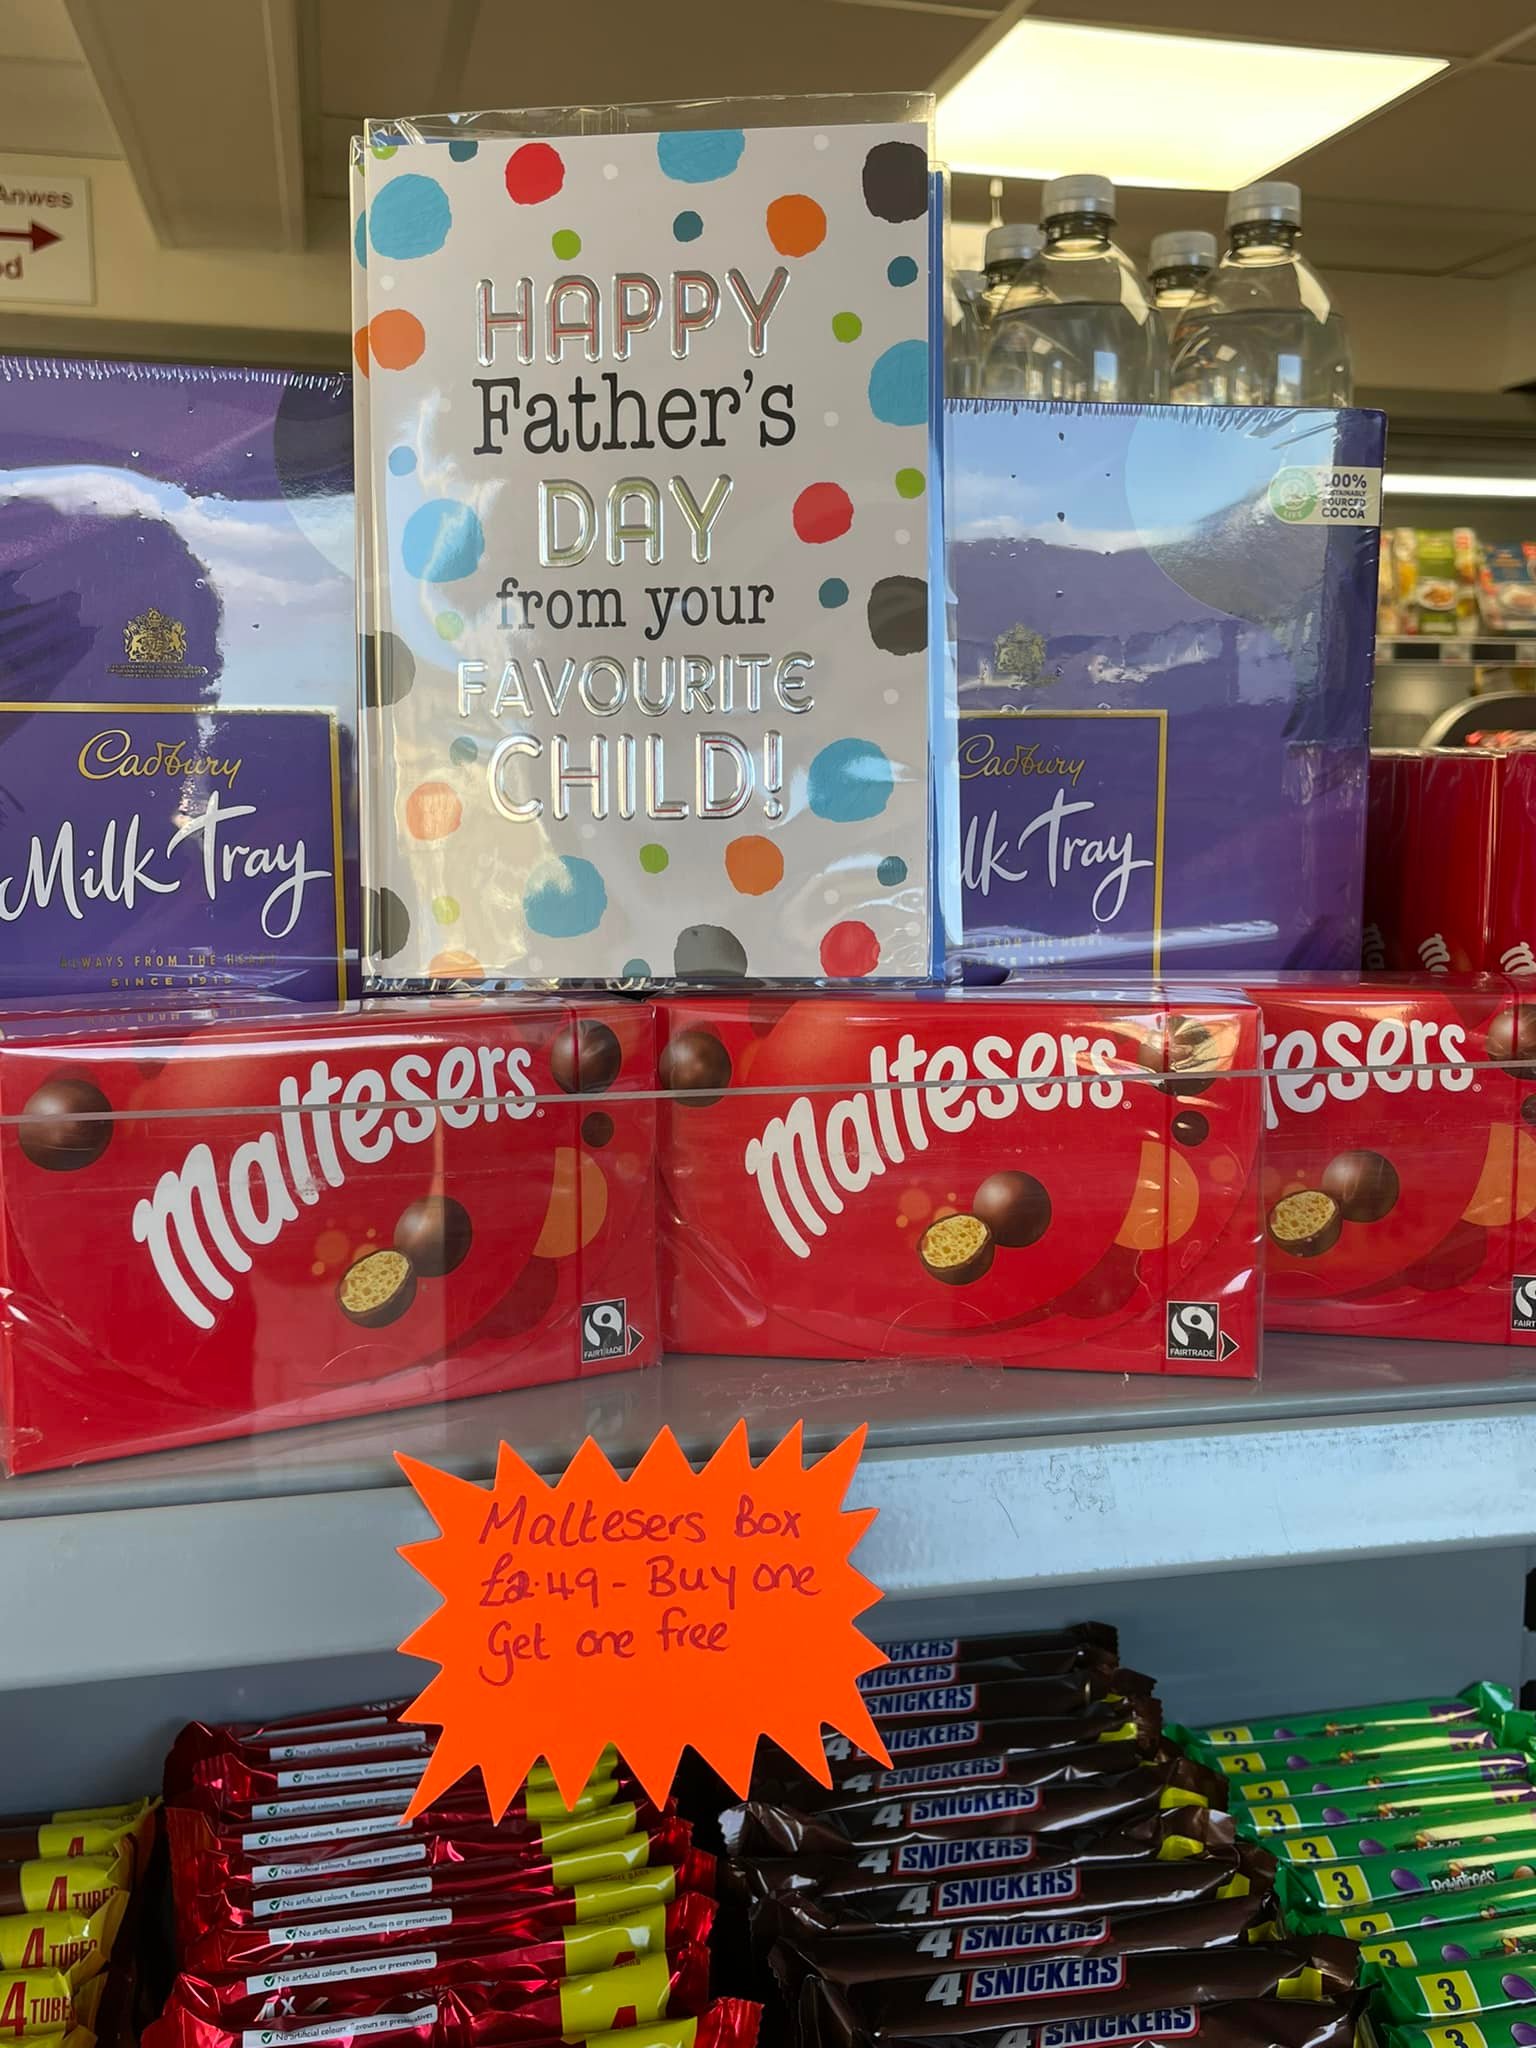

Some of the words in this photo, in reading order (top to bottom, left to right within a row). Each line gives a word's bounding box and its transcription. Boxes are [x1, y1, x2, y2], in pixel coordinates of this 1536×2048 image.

[475, 267, 790, 367] HAPPY
[472, 370, 796, 456] Father's
[537, 473, 734, 567] DAY
[1322, 508, 1365, 518] COCOA
[496, 577, 626, 630] from
[645, 583, 775, 641] your
[457, 651, 815, 718] FAVOURITE
[77, 729, 243, 789] Cadbury
[487, 730, 784, 824] CHILD!
[958, 734, 1087, 786] Cadbury
[0, 814, 180, 921] Milk
[167, 790, 332, 938] Tray
[961, 810, 1028, 896] lk
[1018, 788, 1154, 922] Tray
[111, 977, 174, 987] SINCE
[135, 955, 178, 967] FROM
[188, 955, 216, 967] THE
[1263, 1019, 1473, 1130] tesers
[745, 1031, 1124, 1258] Maltesers
[132, 1046, 537, 1329] Maltesers
[1513, 1319, 1536, 1328] FAIRT
[1169, 1347, 1216, 1358] FAIRTRADE
[479, 1495, 707, 1547] Maltesers
[733, 1495, 802, 1539] Box
[647, 1556, 736, 1610] Buy
[752, 1562, 822, 1597] one
[479, 1621, 551, 1687] Get
[576, 1627, 635, 1658] one
[656, 1607, 730, 1652] free
[880, 1639, 953, 1661] ICKERS
[859, 1663, 952, 1689] NICKERS
[865, 1685, 973, 1715] SNICKERS
[881, 1722, 976, 1751] NICKERS
[841, 1773, 873, 1793] 4
[883, 1755, 1001, 1785] SNICKERS
[872, 1803, 904, 1828] 4
[913, 1786, 1035, 1821] SNICKERS
[858, 1849, 891, 1874] 4
[901, 1837, 1030, 1869] SNICKERS
[46, 1876, 68, 1912] 4
[897, 1886, 931, 1915] 4
[942, 1868, 1073, 1907] SNICKERS
[1332, 1871, 1355, 1902] 3
[21, 1928, 47, 1969] 4
[917, 1928, 953, 1958] 4
[964, 1918, 1103, 1950] SNICKERS
[926, 1973, 963, 2006] 4
[975, 1956, 1119, 1998] SNICKERS
[1437, 1978, 1462, 2011] 3
[0, 1981, 27, 2037] 4
[996, 2026, 1031, 2048] 4
[1045, 2006, 1192, 2046] SNICKERS
